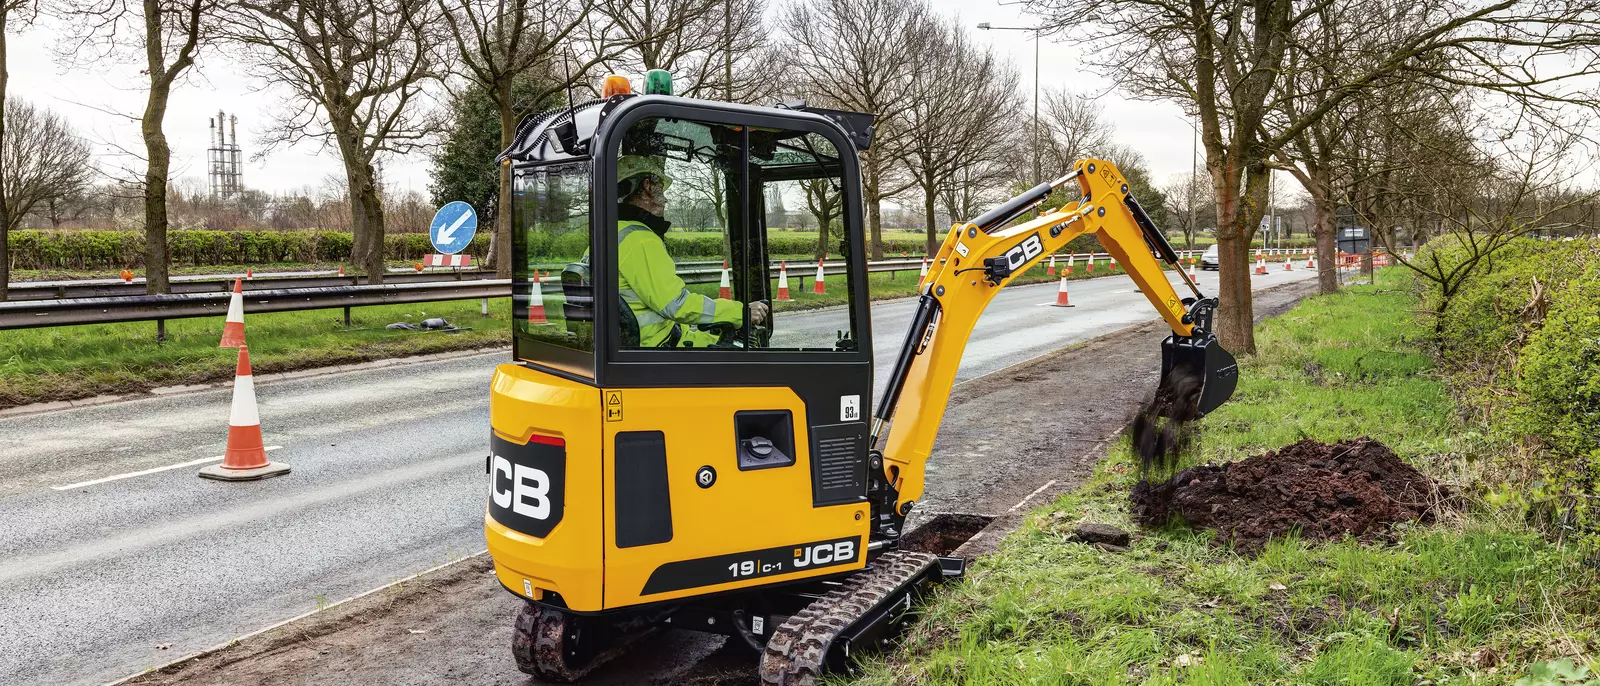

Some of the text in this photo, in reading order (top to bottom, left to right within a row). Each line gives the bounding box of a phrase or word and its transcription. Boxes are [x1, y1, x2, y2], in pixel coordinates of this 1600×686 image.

[1005, 235, 1043, 271] CB
[489, 450, 551, 520] CB
[728, 560, 755, 577] 19
[793, 541, 855, 568] JCB
